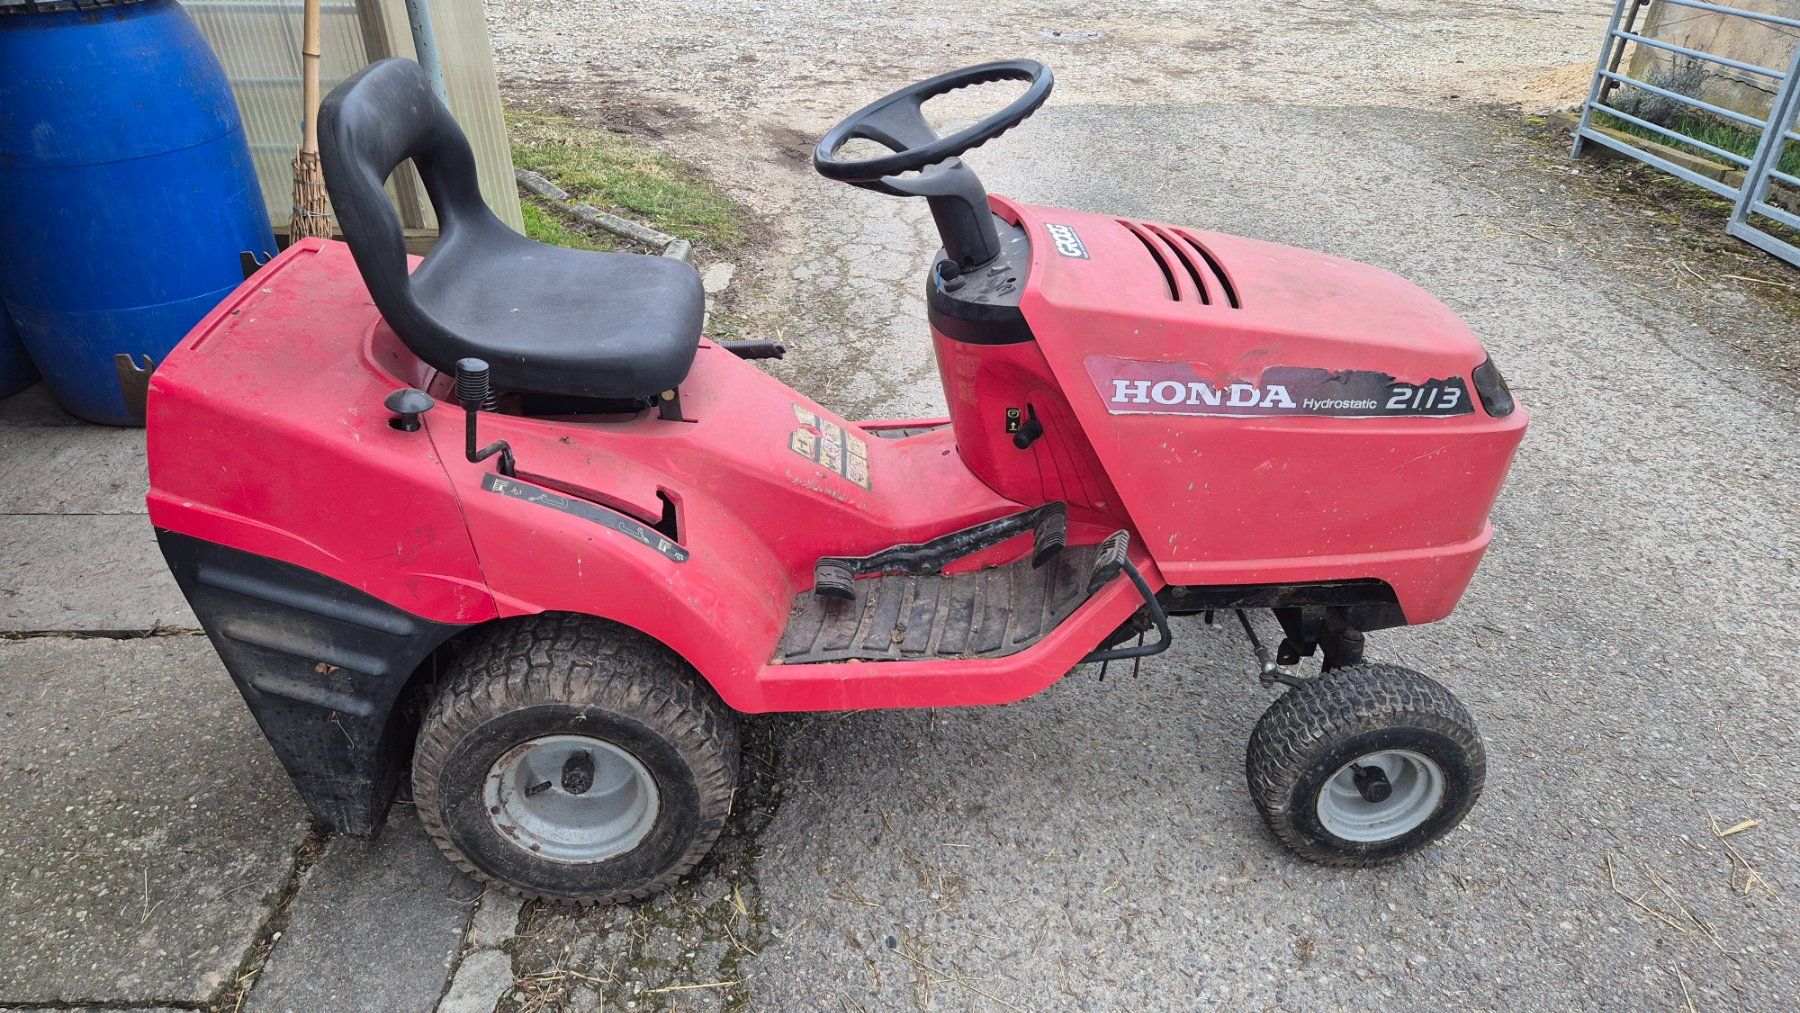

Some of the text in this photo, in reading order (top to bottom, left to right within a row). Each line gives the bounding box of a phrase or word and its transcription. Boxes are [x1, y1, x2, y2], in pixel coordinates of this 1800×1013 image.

[1111, 379, 1461, 411] HONDA Hydrostatic 2113
